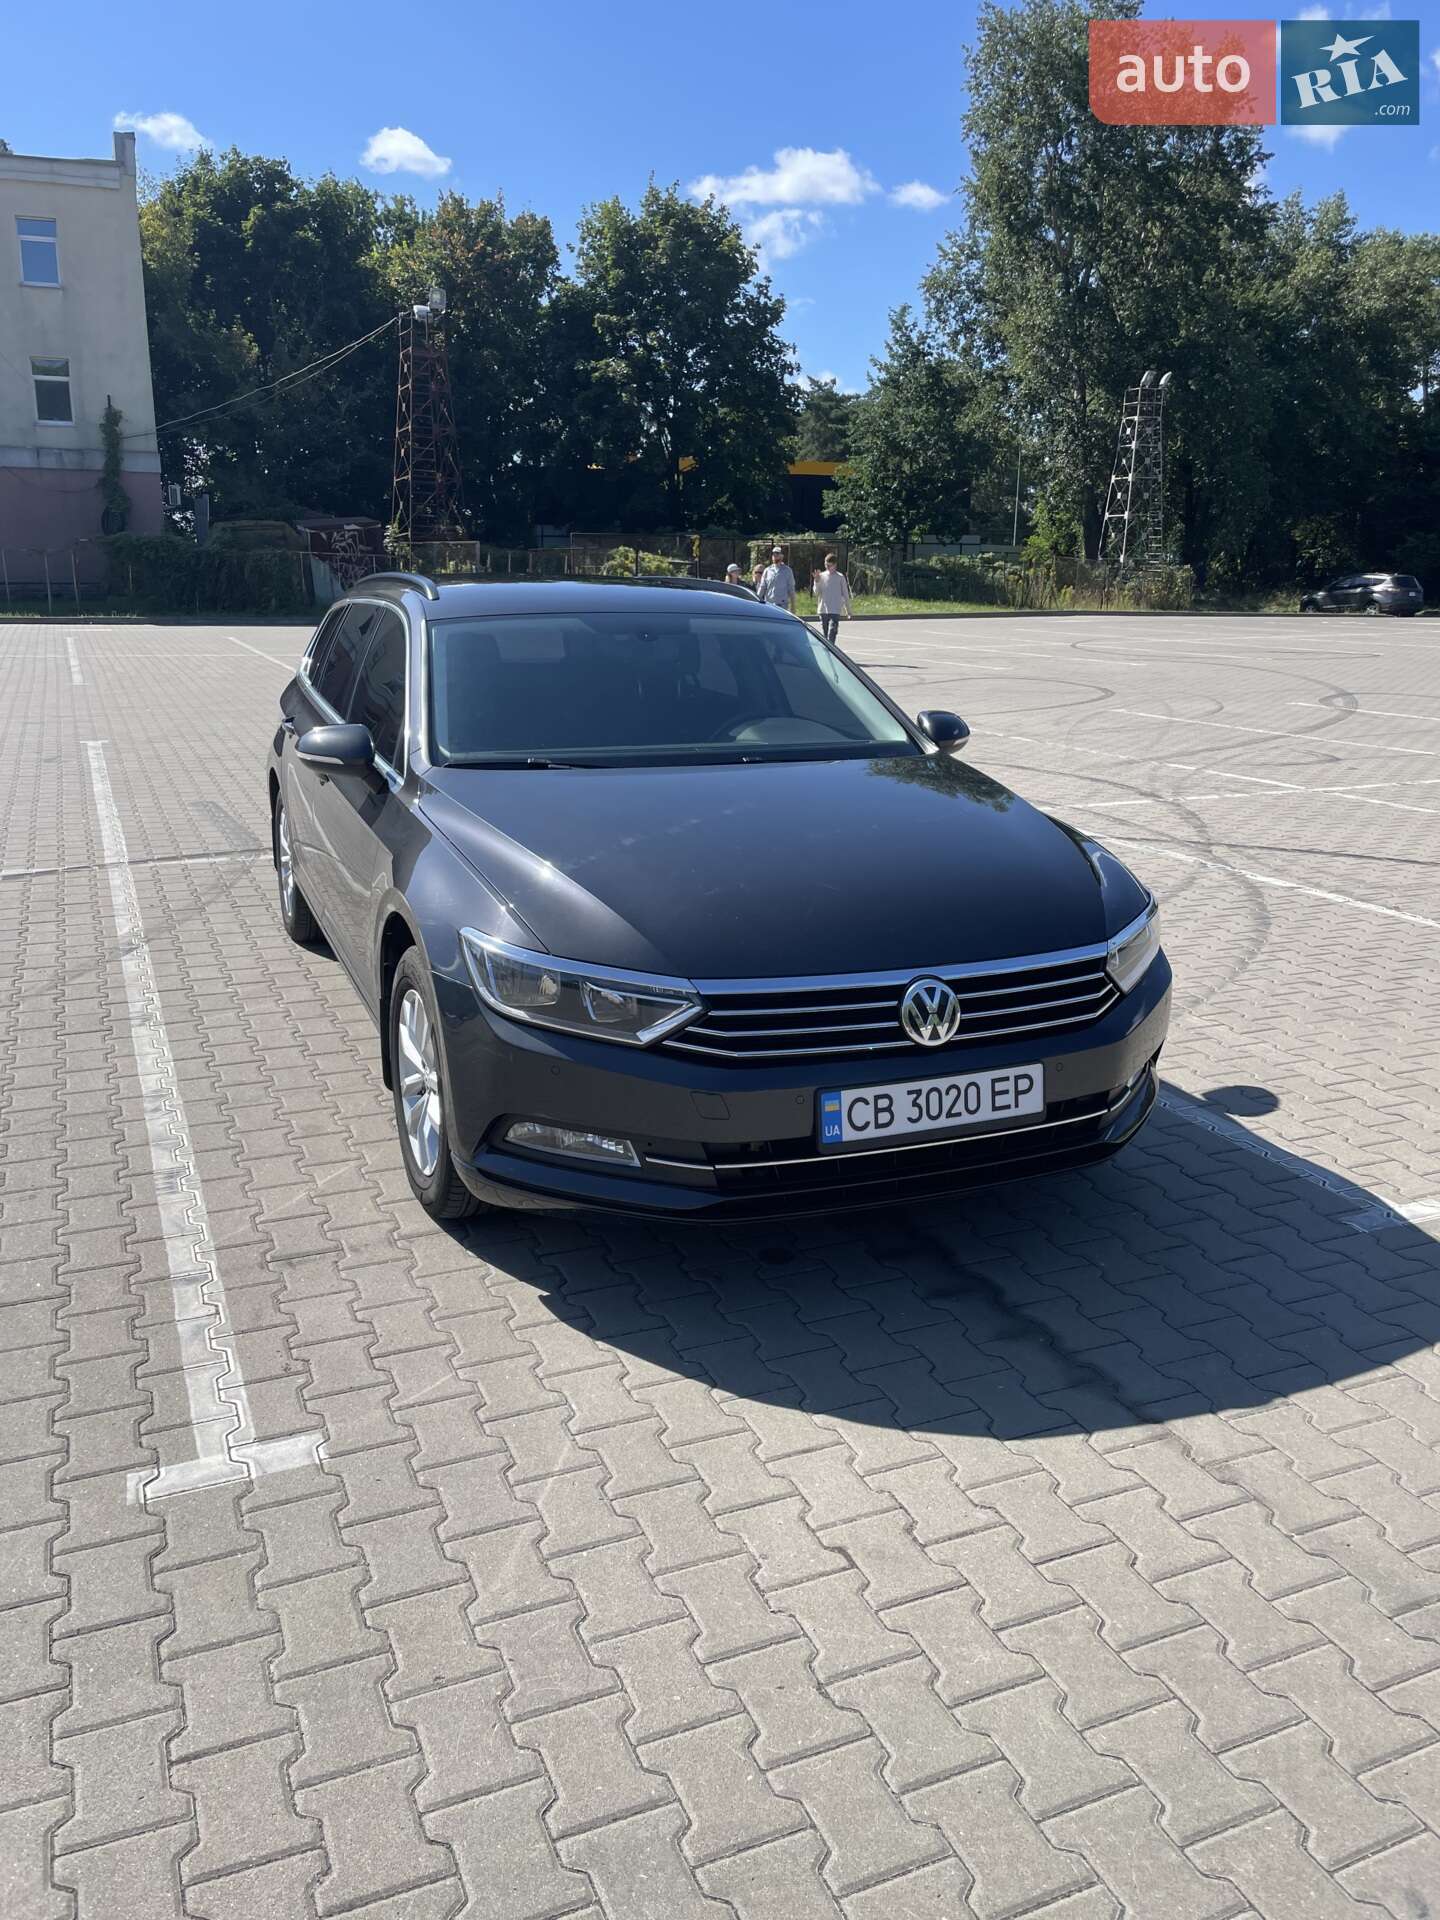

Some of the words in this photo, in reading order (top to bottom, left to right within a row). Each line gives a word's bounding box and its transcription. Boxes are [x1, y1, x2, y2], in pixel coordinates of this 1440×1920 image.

[902, 979, 961, 1046] VW
[825, 1125, 841, 1137] UA
[847, 1093, 895, 1132] CB
[906, 1081, 981, 1124] 3020
[990, 1073, 1034, 1112] EP
